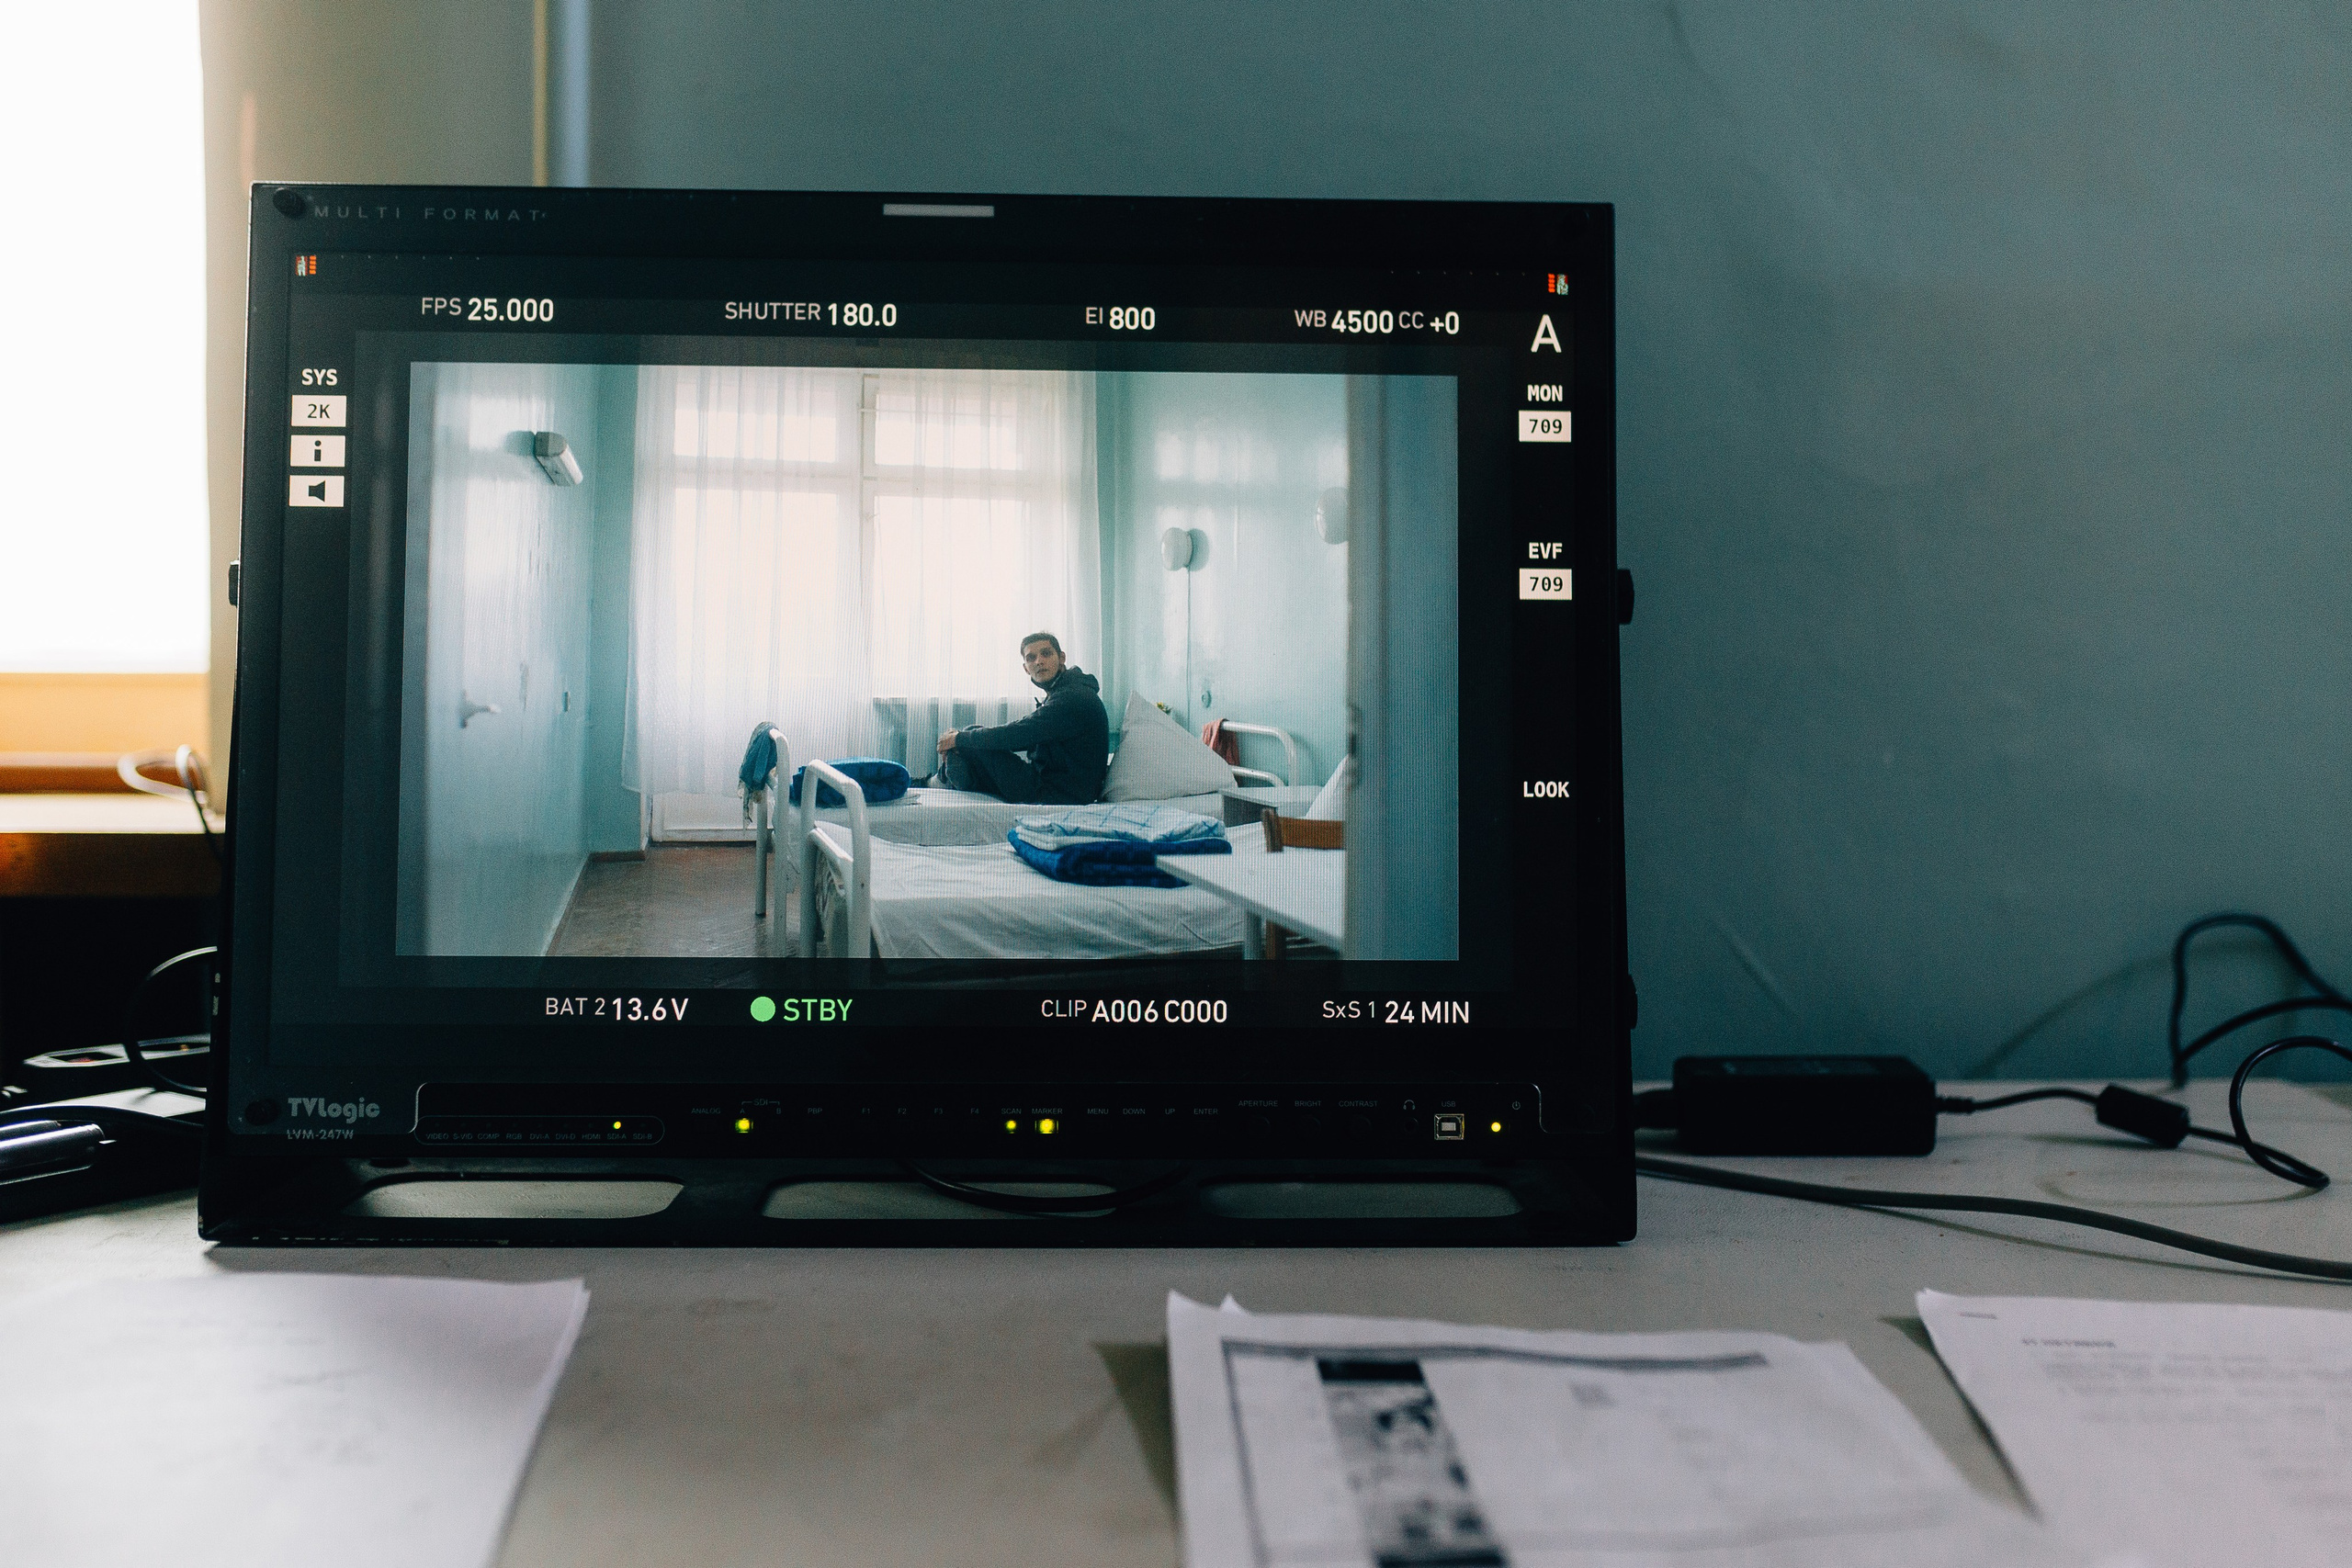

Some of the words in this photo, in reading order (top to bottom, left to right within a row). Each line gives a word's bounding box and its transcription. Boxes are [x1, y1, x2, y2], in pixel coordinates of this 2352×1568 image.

[313, 204, 400, 220] MULTI
[424, 207, 539, 221] FORMAT
[421, 297, 462, 316] FPS
[467, 297, 554, 322] 25.000
[725, 300, 821, 321] SHUTTER
[828, 302, 898, 327] 180.0
[1085, 306, 1103, 325] EI
[1109, 306, 1156, 331] 800
[1294, 310, 1327, 328] WB
[1330, 310, 1394, 334] 4500
[1398, 310, 1424, 330] CC
[1430, 310, 1460, 335] +0
[1530, 313, 1562, 354] A
[301, 367, 338, 386] SYS
[1527, 384, 1564, 402] MON
[307, 403, 331, 419] 2K
[1529, 418, 1563, 434] 709
[1528, 542, 1563, 559] EVF
[1530, 576, 1564, 592] 709
[1522, 780, 1570, 798] LOOK
[545, 997, 589, 1016] BAT
[594, 997, 605, 1016] 2
[783, 998, 854, 1022] STBY
[1041, 998, 1088, 1018] CLIP
[1322, 999, 1362, 1019] SxS
[1368, 1000, 1375, 1019] 1
[1385, 1000, 1415, 1024] 24
[1421, 1000, 1469, 1024] MIN
[288, 1097, 380, 1124] TVLogic
[753, 1098, 769, 1107] SDI
[1238, 1100, 1278, 1108] APERTURE
[1294, 1100, 1322, 1108] BRIGHT
[1338, 1100, 1378, 1108] CONTRAST
[1441, 1100, 1456, 1108] USB
[690, 1107, 721, 1115] ANALOG
[775, 1107, 782, 1115] B
[807, 1107, 823, 1115] PBP
[897, 1107, 908, 1115] F2
[933, 1107, 944, 1115] F3
[1001, 1107, 1023, 1115] SCAN
[1031, 1107, 1063, 1115] MARKER
[1122, 1107, 1147, 1115] DOWN
[1193, 1107, 1218, 1115] ENTER
[286, 1128, 355, 1140] LVM-247W
[452, 1132, 474, 1141] S-VID
